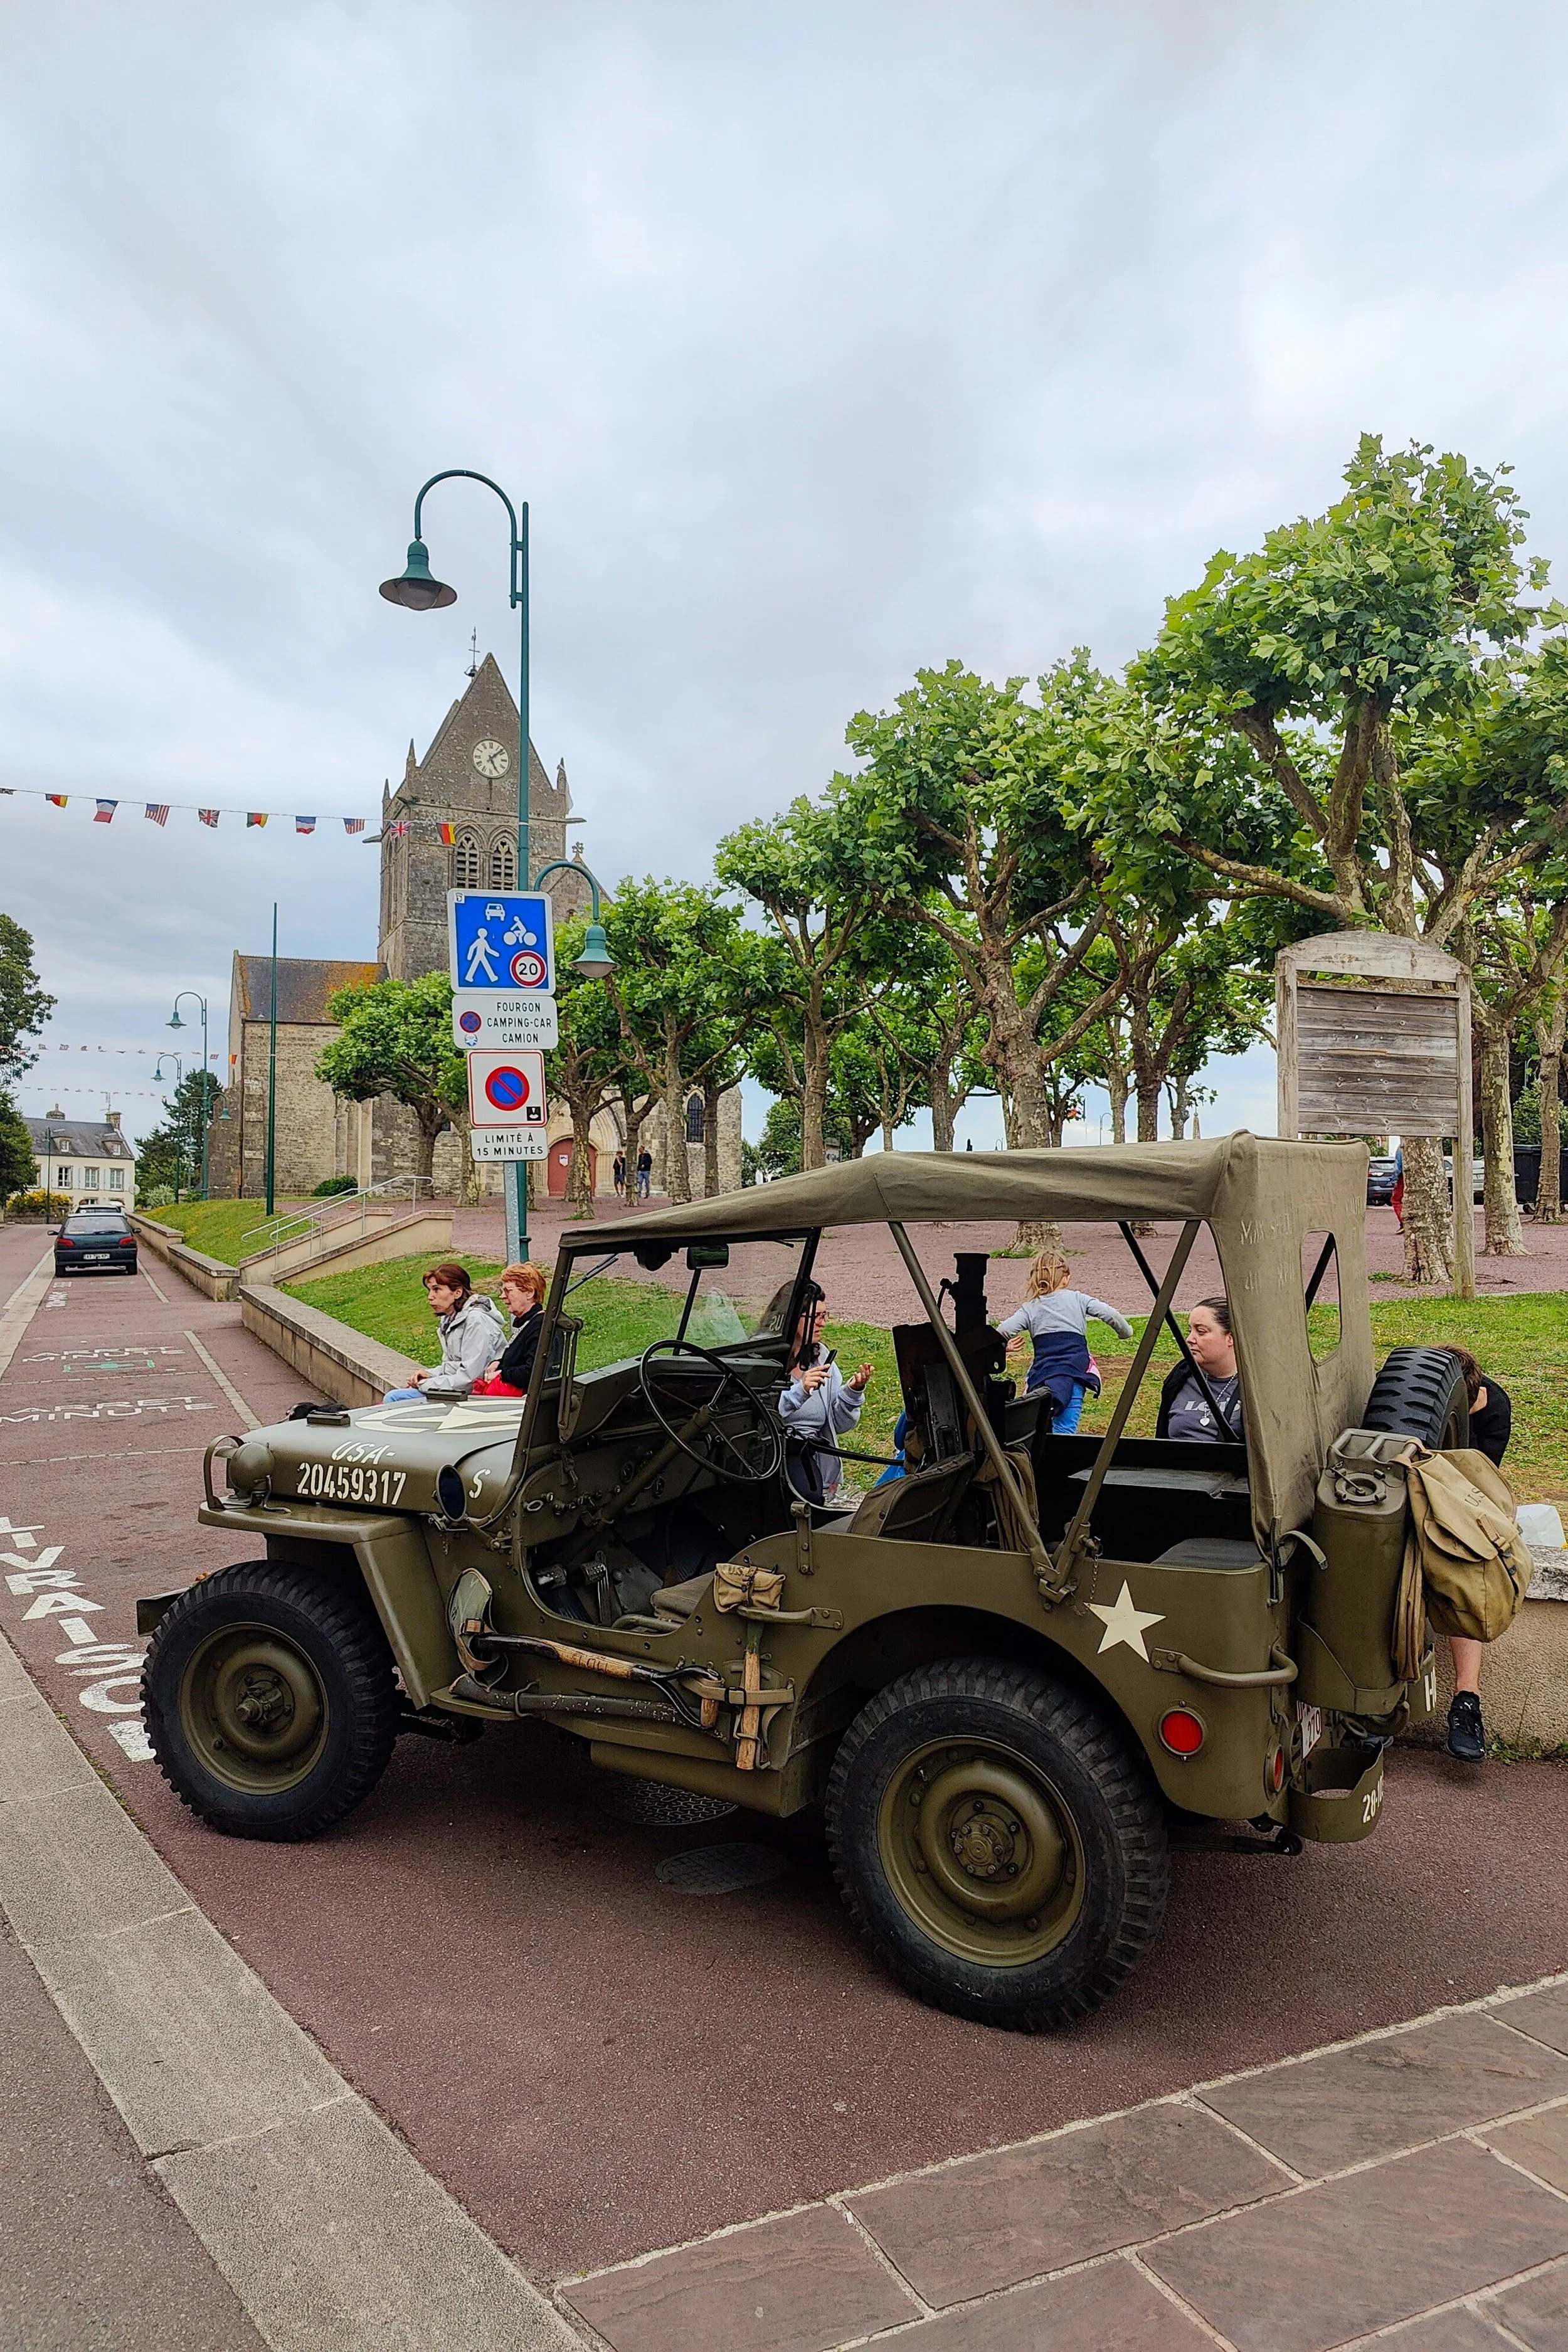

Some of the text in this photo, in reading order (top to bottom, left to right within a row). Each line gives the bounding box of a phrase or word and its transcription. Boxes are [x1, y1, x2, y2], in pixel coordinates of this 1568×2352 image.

[519, 963, 538, 975] 20
[497, 1002, 541, 1012] FOURGON
[487, 1017, 552, 1027] CAMPING-CAR
[502, 1033, 539, 1043] CAMION
[485, 1132, 534, 1143] LIMITÉ À
[477, 1146, 543, 1156] 15 MINUTES
[10, 1396, 203, 1415] ARRET
[297, 1462, 406, 1505] 20459317
